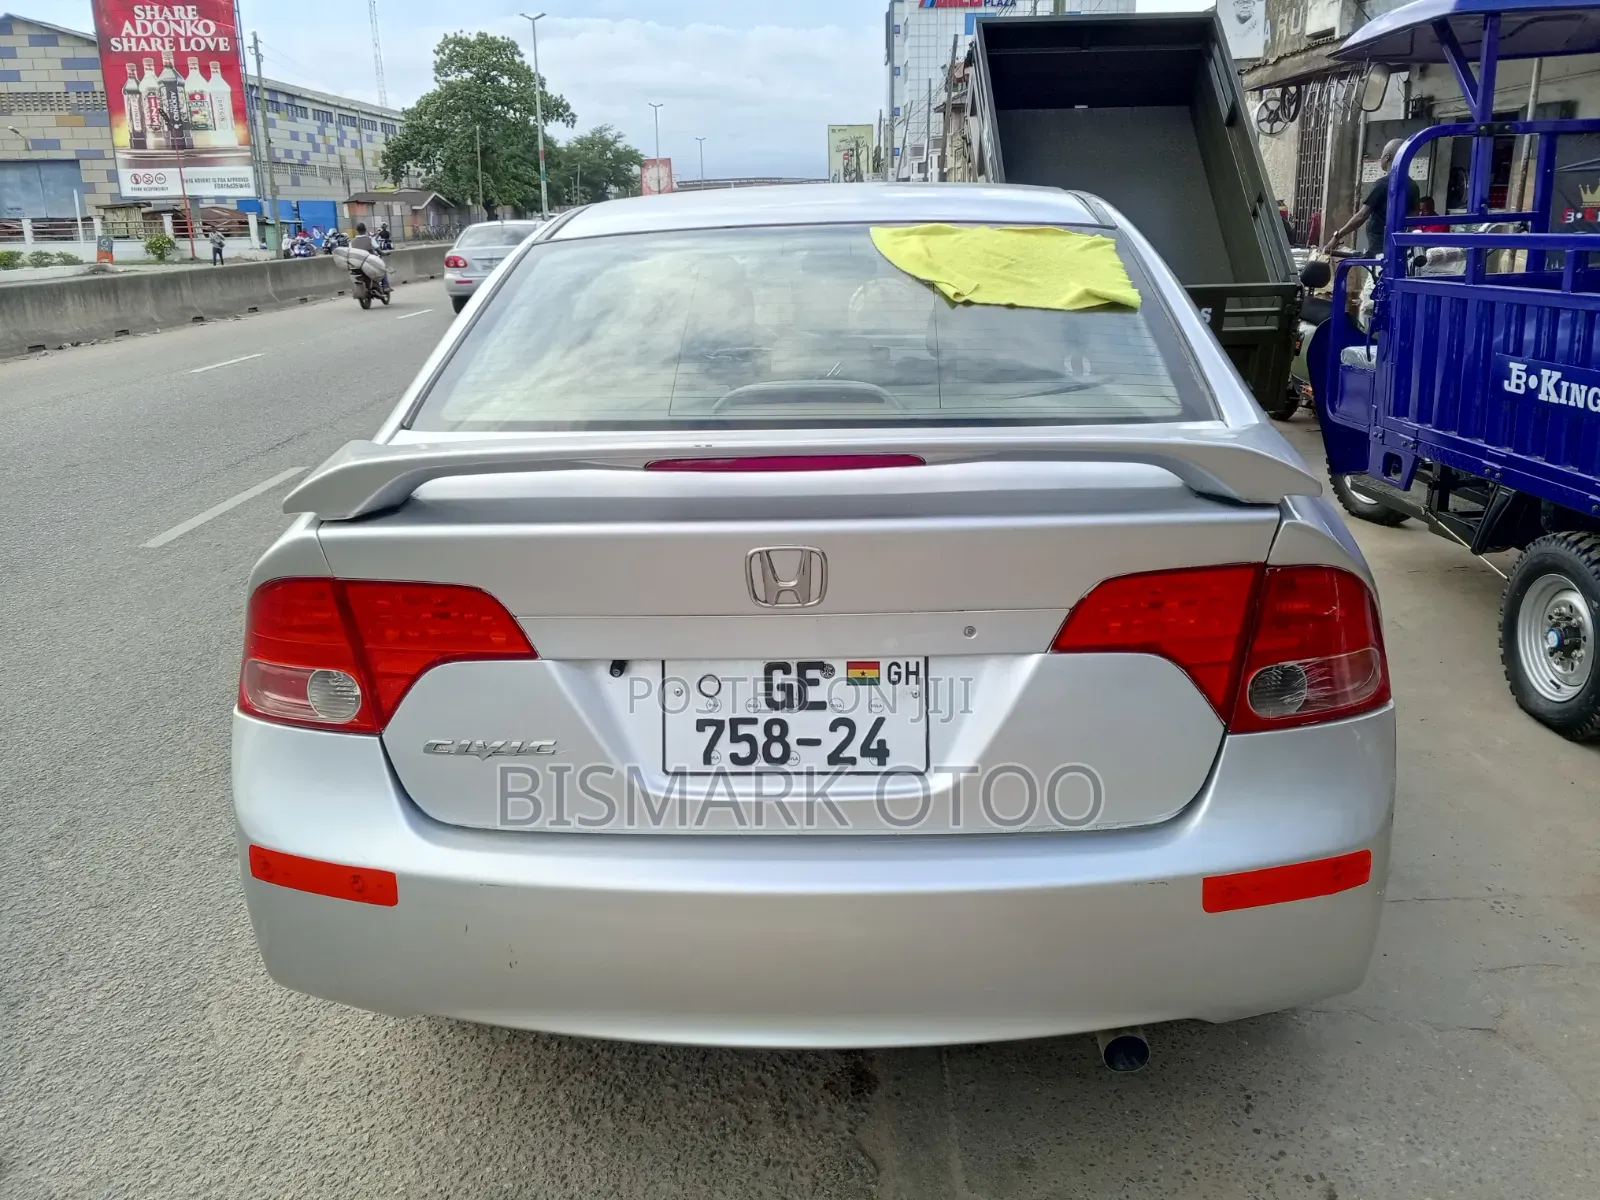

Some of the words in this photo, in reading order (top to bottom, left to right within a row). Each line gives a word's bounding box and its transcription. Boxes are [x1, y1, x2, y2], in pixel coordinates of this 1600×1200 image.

[133, 5, 198, 20] SHARE
[121, 20, 216, 37] ADONKO
[110, 37, 176, 52] SHARE
[179, 37, 230, 52] LOVE
[764, 661, 827, 711] GE
[887, 661, 920, 686] GH
[423, 739, 557, 761] CIVIC
[696, 716, 890, 767] 758-24
